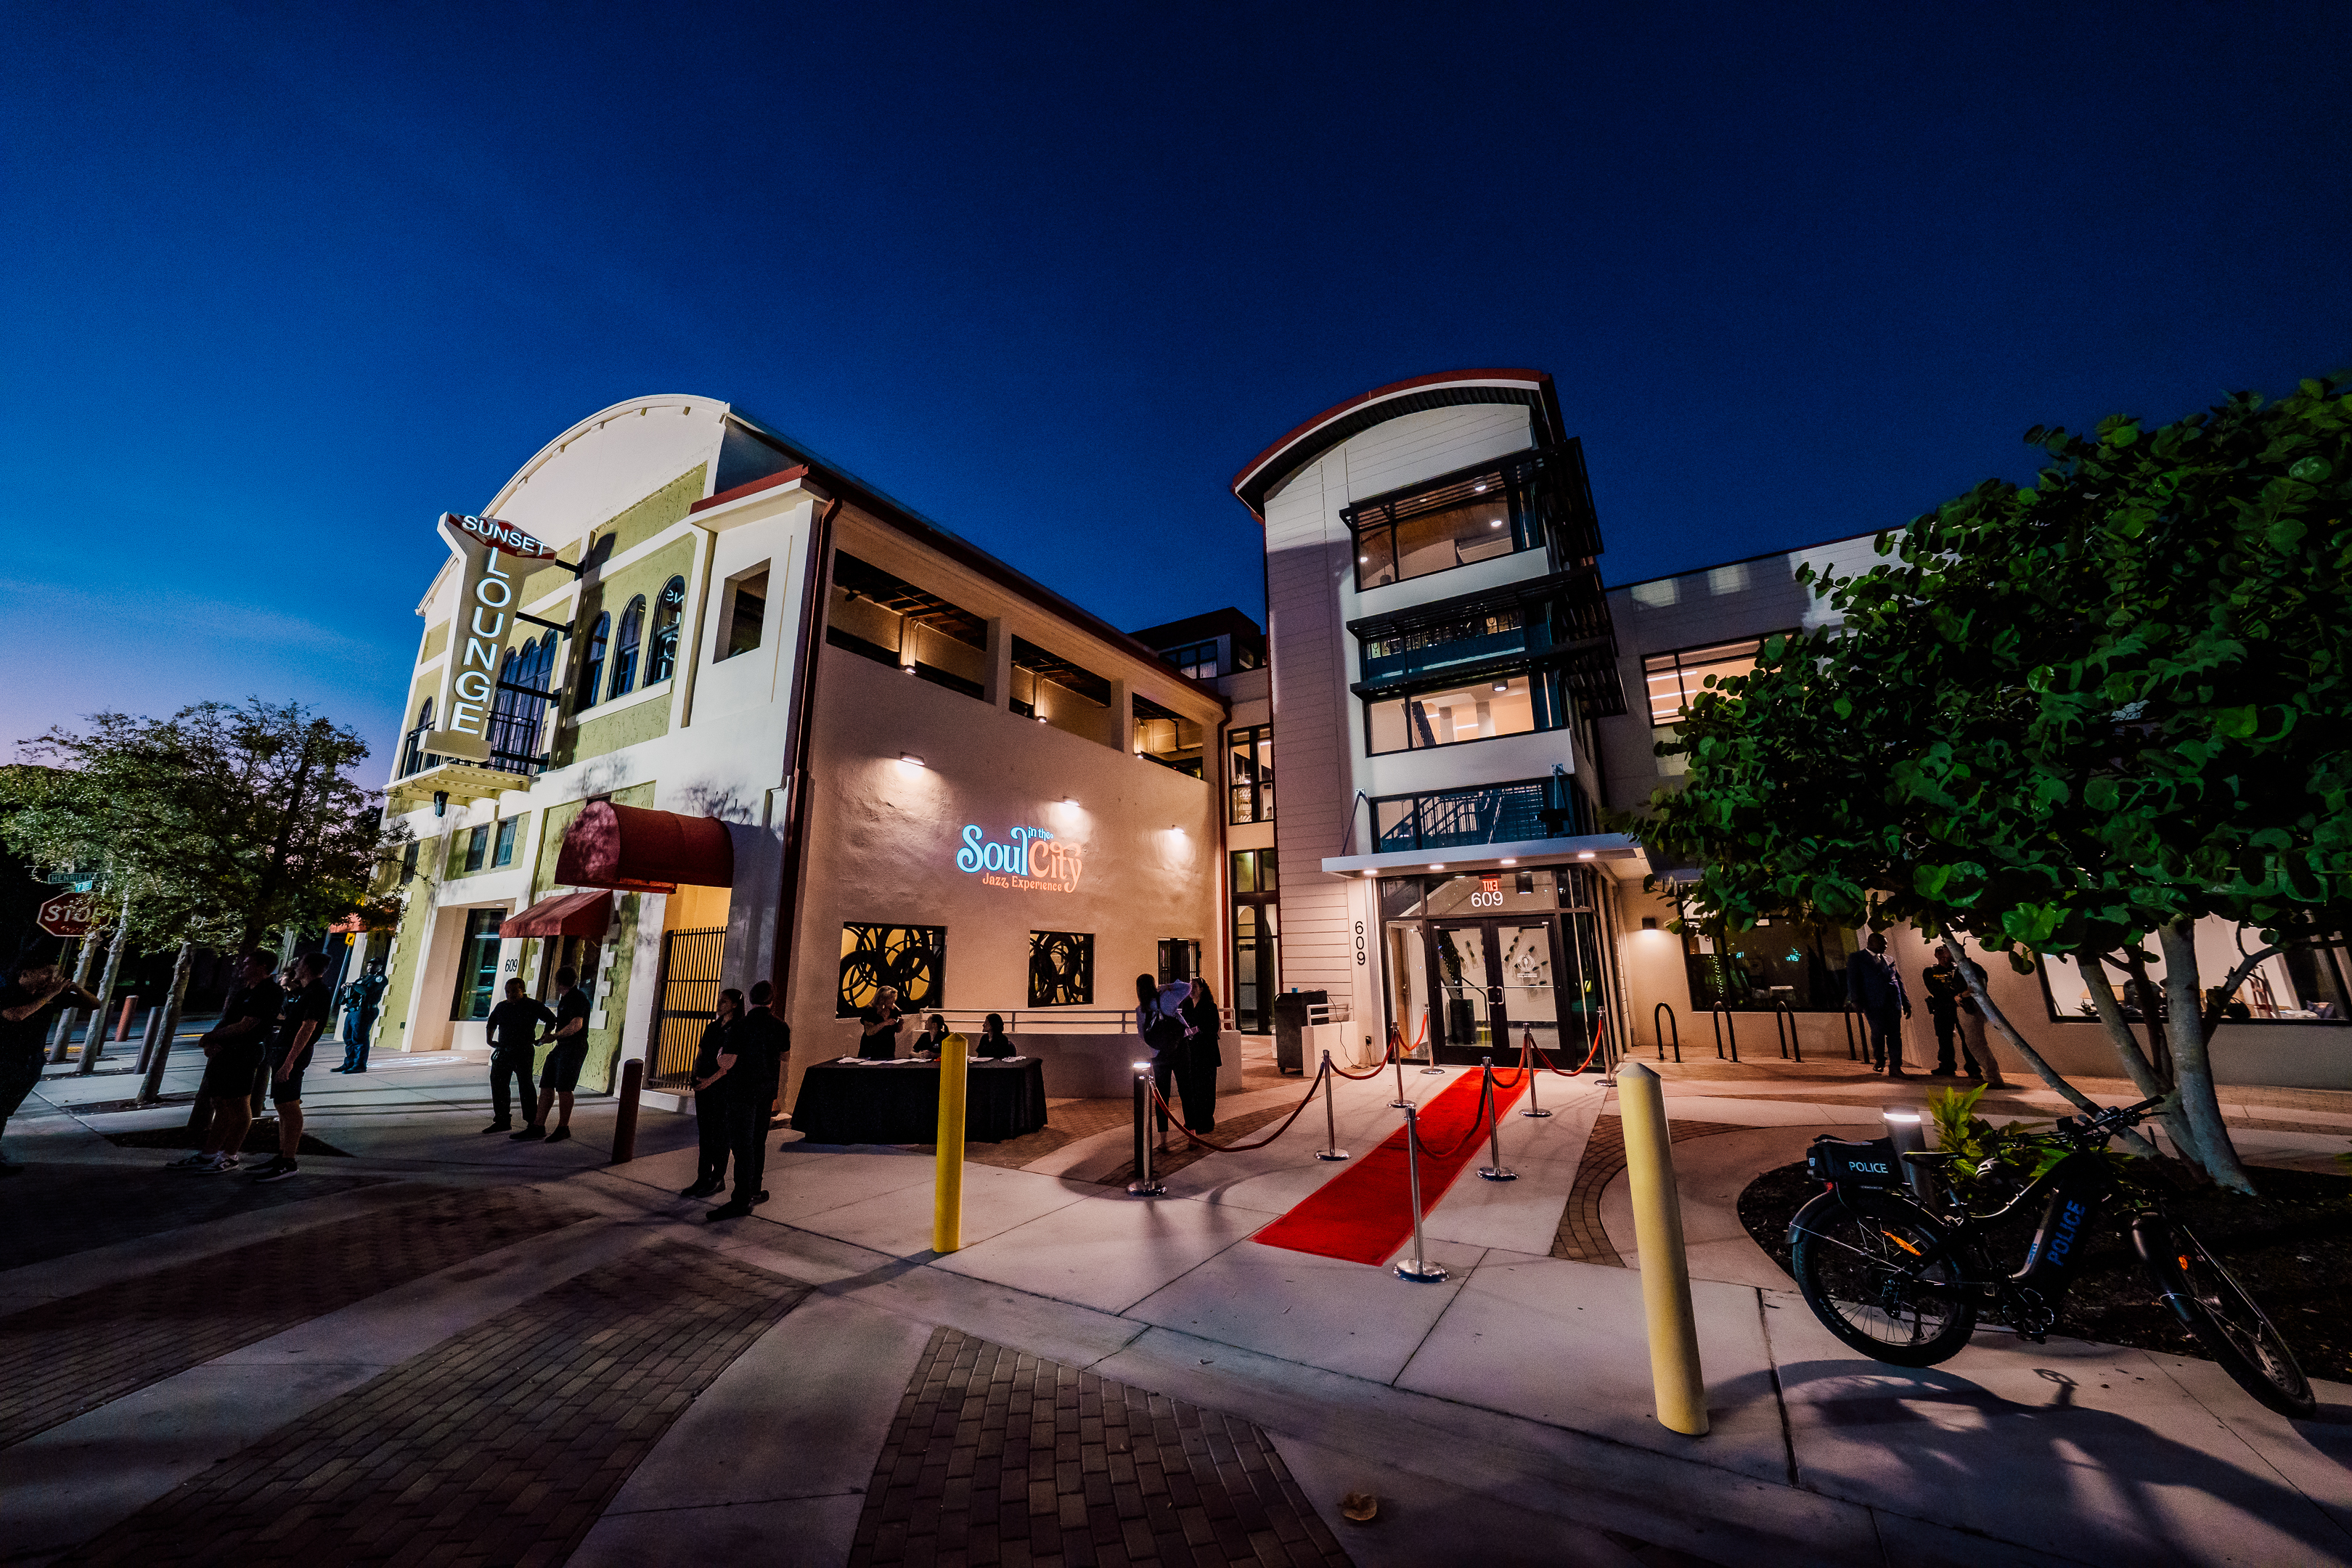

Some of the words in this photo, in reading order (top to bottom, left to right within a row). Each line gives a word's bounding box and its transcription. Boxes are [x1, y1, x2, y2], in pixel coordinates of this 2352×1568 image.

[462, 515, 550, 556] SUNSET
[449, 546, 511, 735] LOUNGE
[1027, 825, 1037, 838] in
[1038, 828, 1054, 841] the
[956, 824, 1029, 875] Soul
[1029, 840, 1082, 893] City
[982, 873, 1009, 889] Jazz
[1011, 875, 1063, 891] Experience
[1471, 891, 1503, 907] 609
[44, 905, 107, 923] STOP
[1355, 920, 1366, 965] 609
[505, 959, 518, 972] 609
[1848, 1161, 1889, 1174] POLICE
[2046, 1199, 2086, 1267] POLICE
